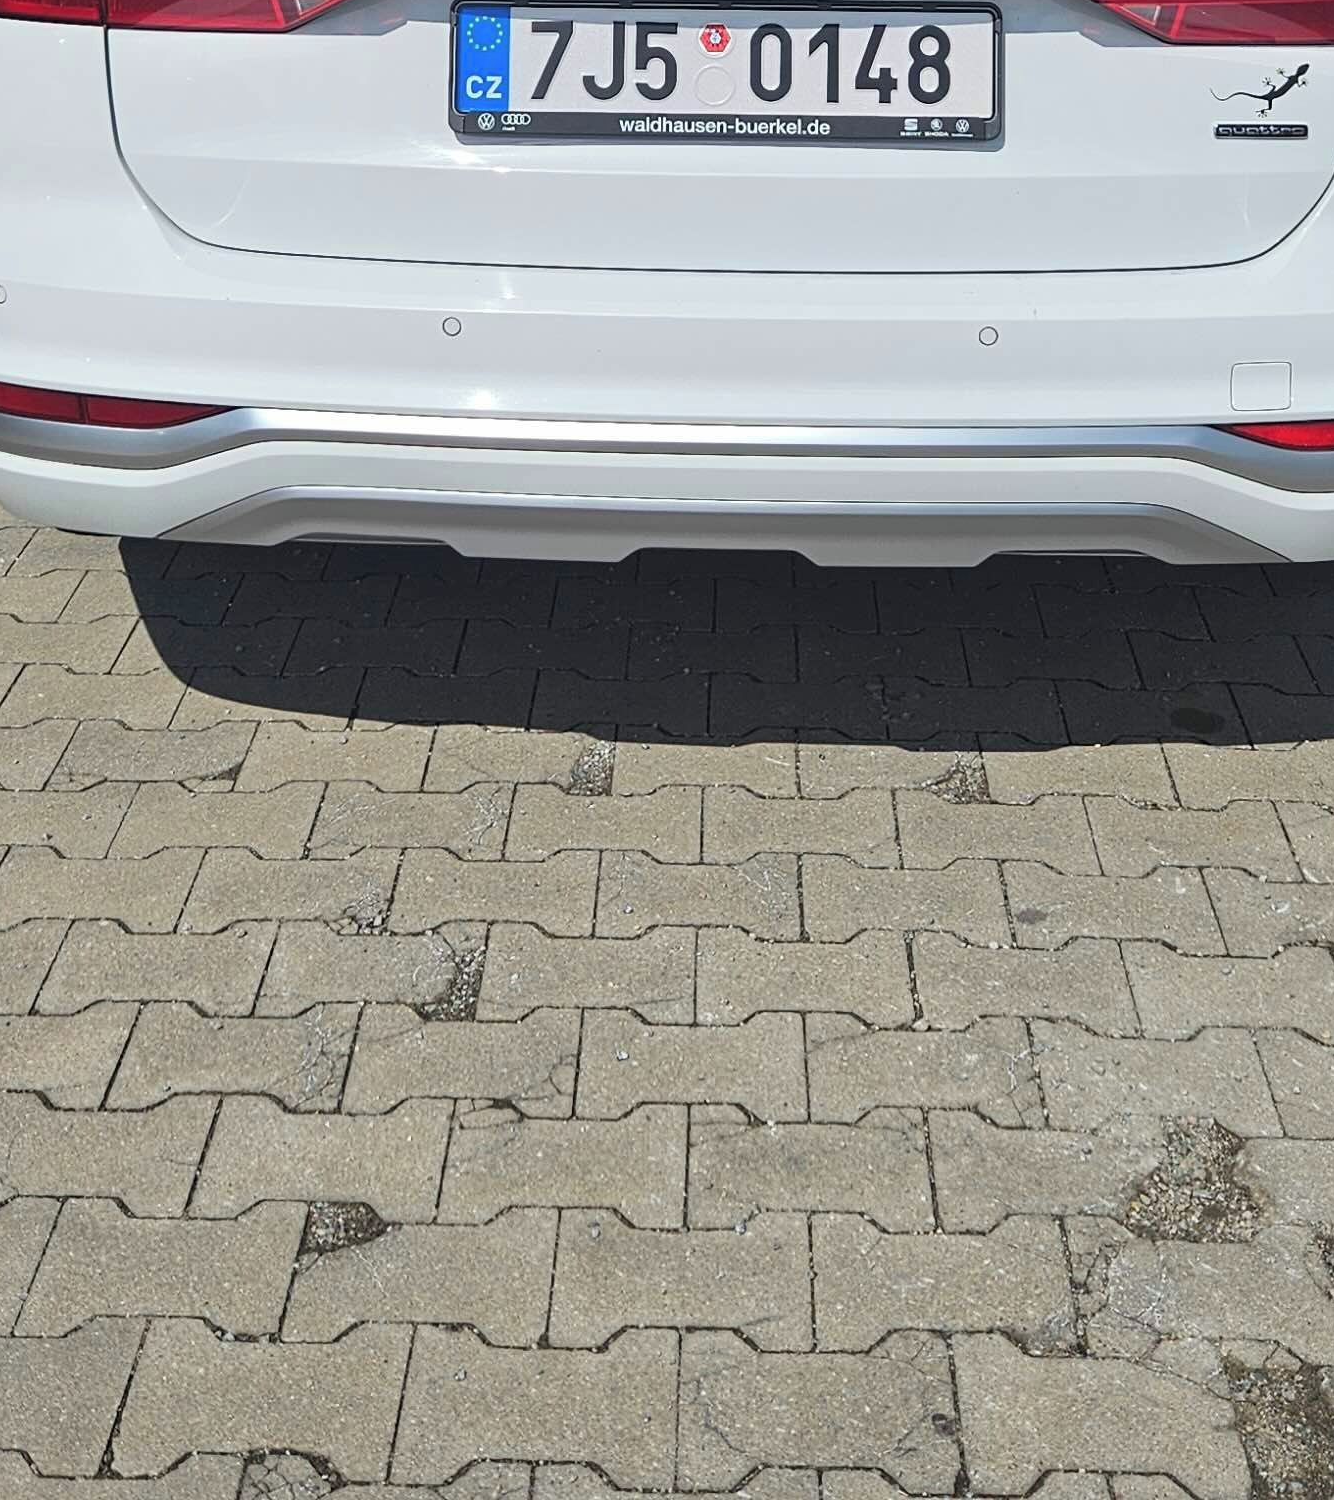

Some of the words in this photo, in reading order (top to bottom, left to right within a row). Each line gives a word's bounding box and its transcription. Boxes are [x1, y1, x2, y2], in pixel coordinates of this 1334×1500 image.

[530, 20, 678, 100] 7J5
[749, 23, 951, 104] 0148
[465, 75, 502, 99] CZ
[619, 116, 831, 136] waldhausen-buerkel.de
[1218, 126, 1306, 136] quattro
